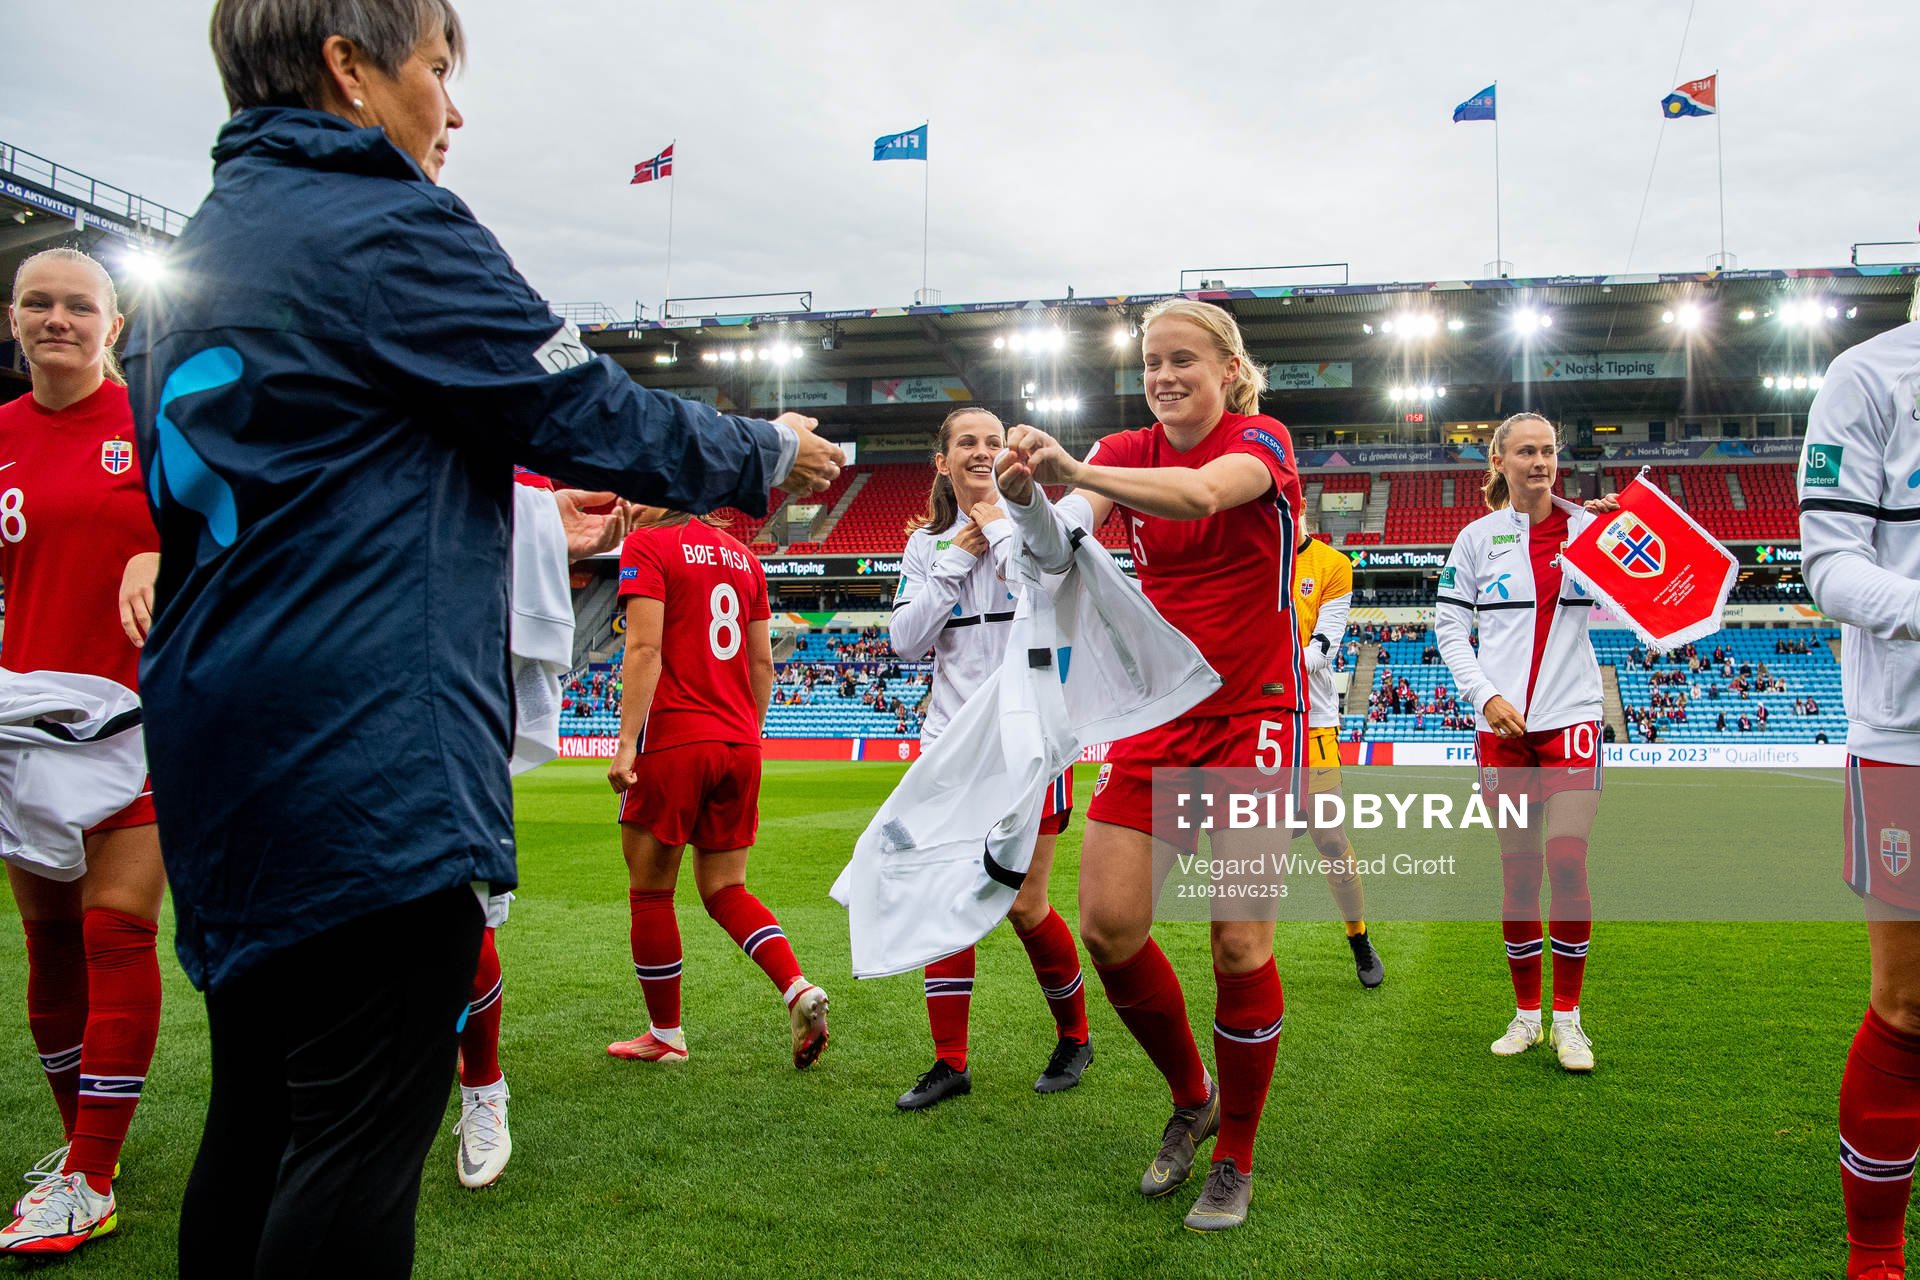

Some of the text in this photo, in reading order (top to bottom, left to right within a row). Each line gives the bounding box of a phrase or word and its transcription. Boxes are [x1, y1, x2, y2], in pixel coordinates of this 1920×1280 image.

[7, 184, 22, 197] OG
[24, 190, 75, 215] AKTIVITET
[83, 211, 100, 226] GIR
[1566, 360, 1655, 376] Norsk Tipping
[1638, 447, 1689, 457] Norsk Tipping
[1132, 515, 1148, 567] 5
[682, 544, 752, 574] BØE RISA
[789, 562, 824, 575] Tipping
[1370, 552, 1445, 566] Norsk Tipping
[709, 583, 741, 660] 8
[1255, 720, 1282, 776] 5
[1563, 723, 1594, 759] 10
[1629, 749, 1661, 764] Cup
[1725, 749, 1799, 763] Qualifiers
